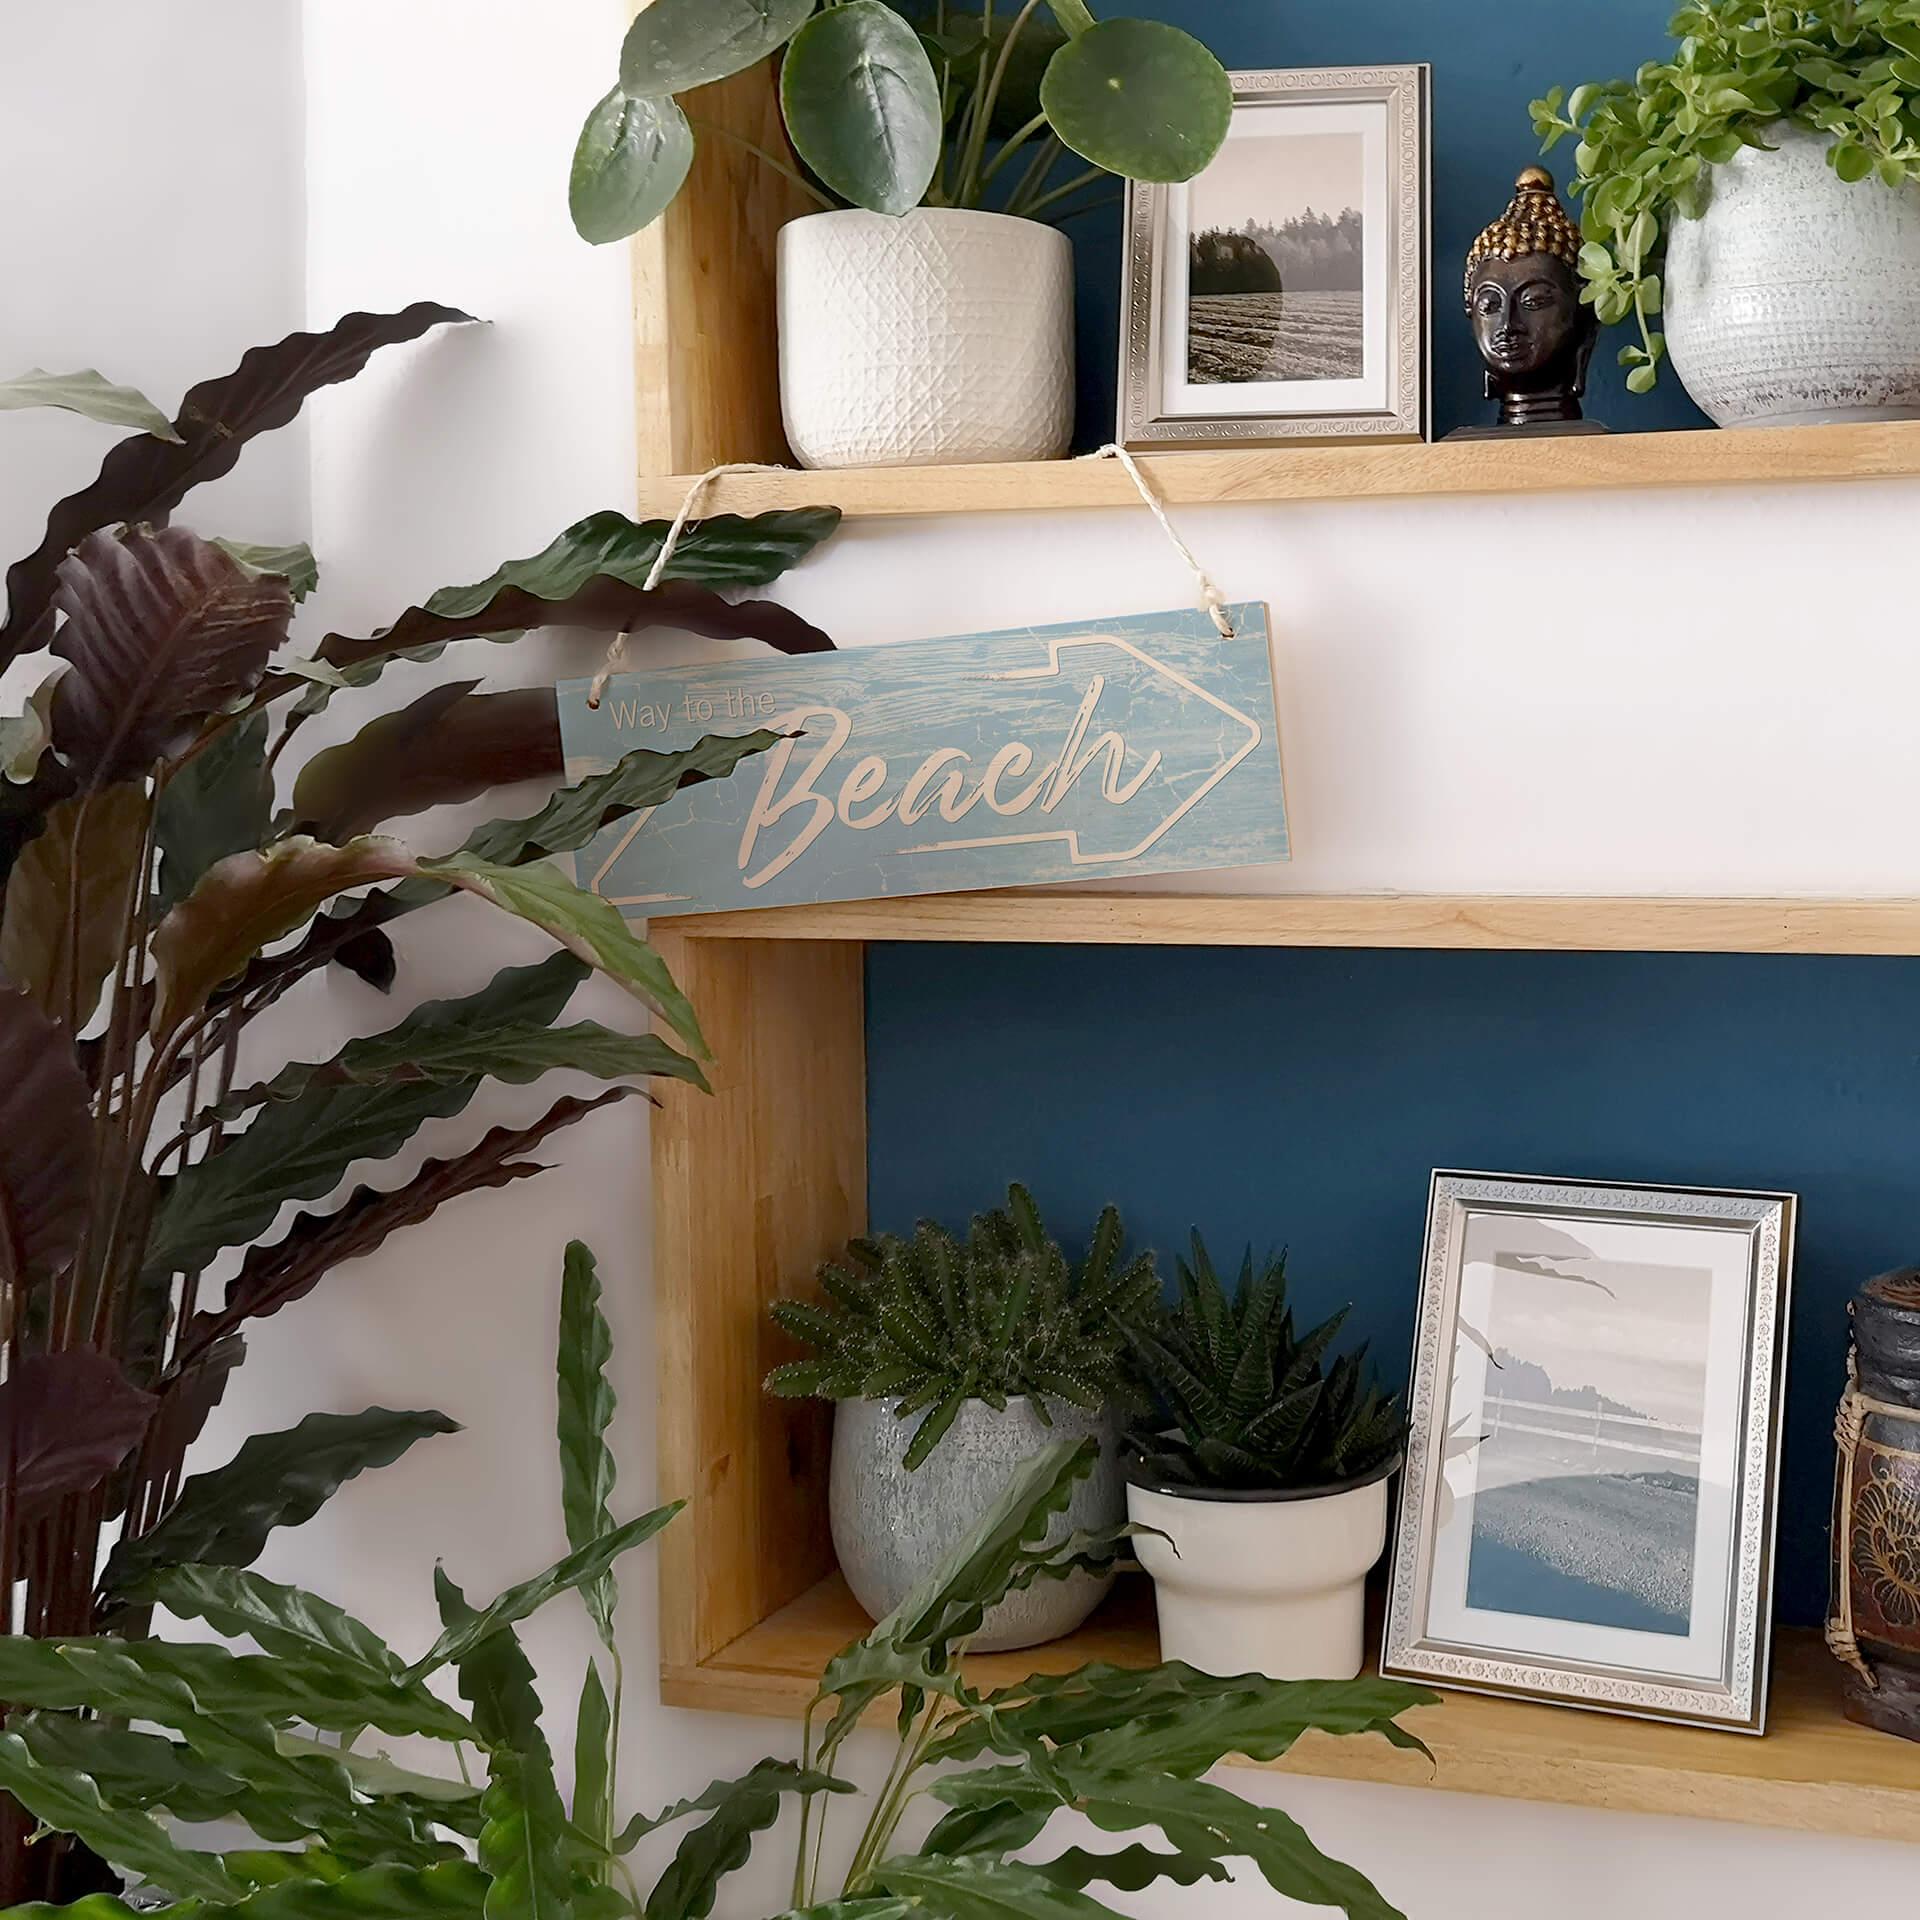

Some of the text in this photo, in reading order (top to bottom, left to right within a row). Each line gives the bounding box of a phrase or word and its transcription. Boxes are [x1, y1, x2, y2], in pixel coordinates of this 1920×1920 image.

[609, 687, 777, 732] Way to the
[738, 675, 1161, 888] Beach
